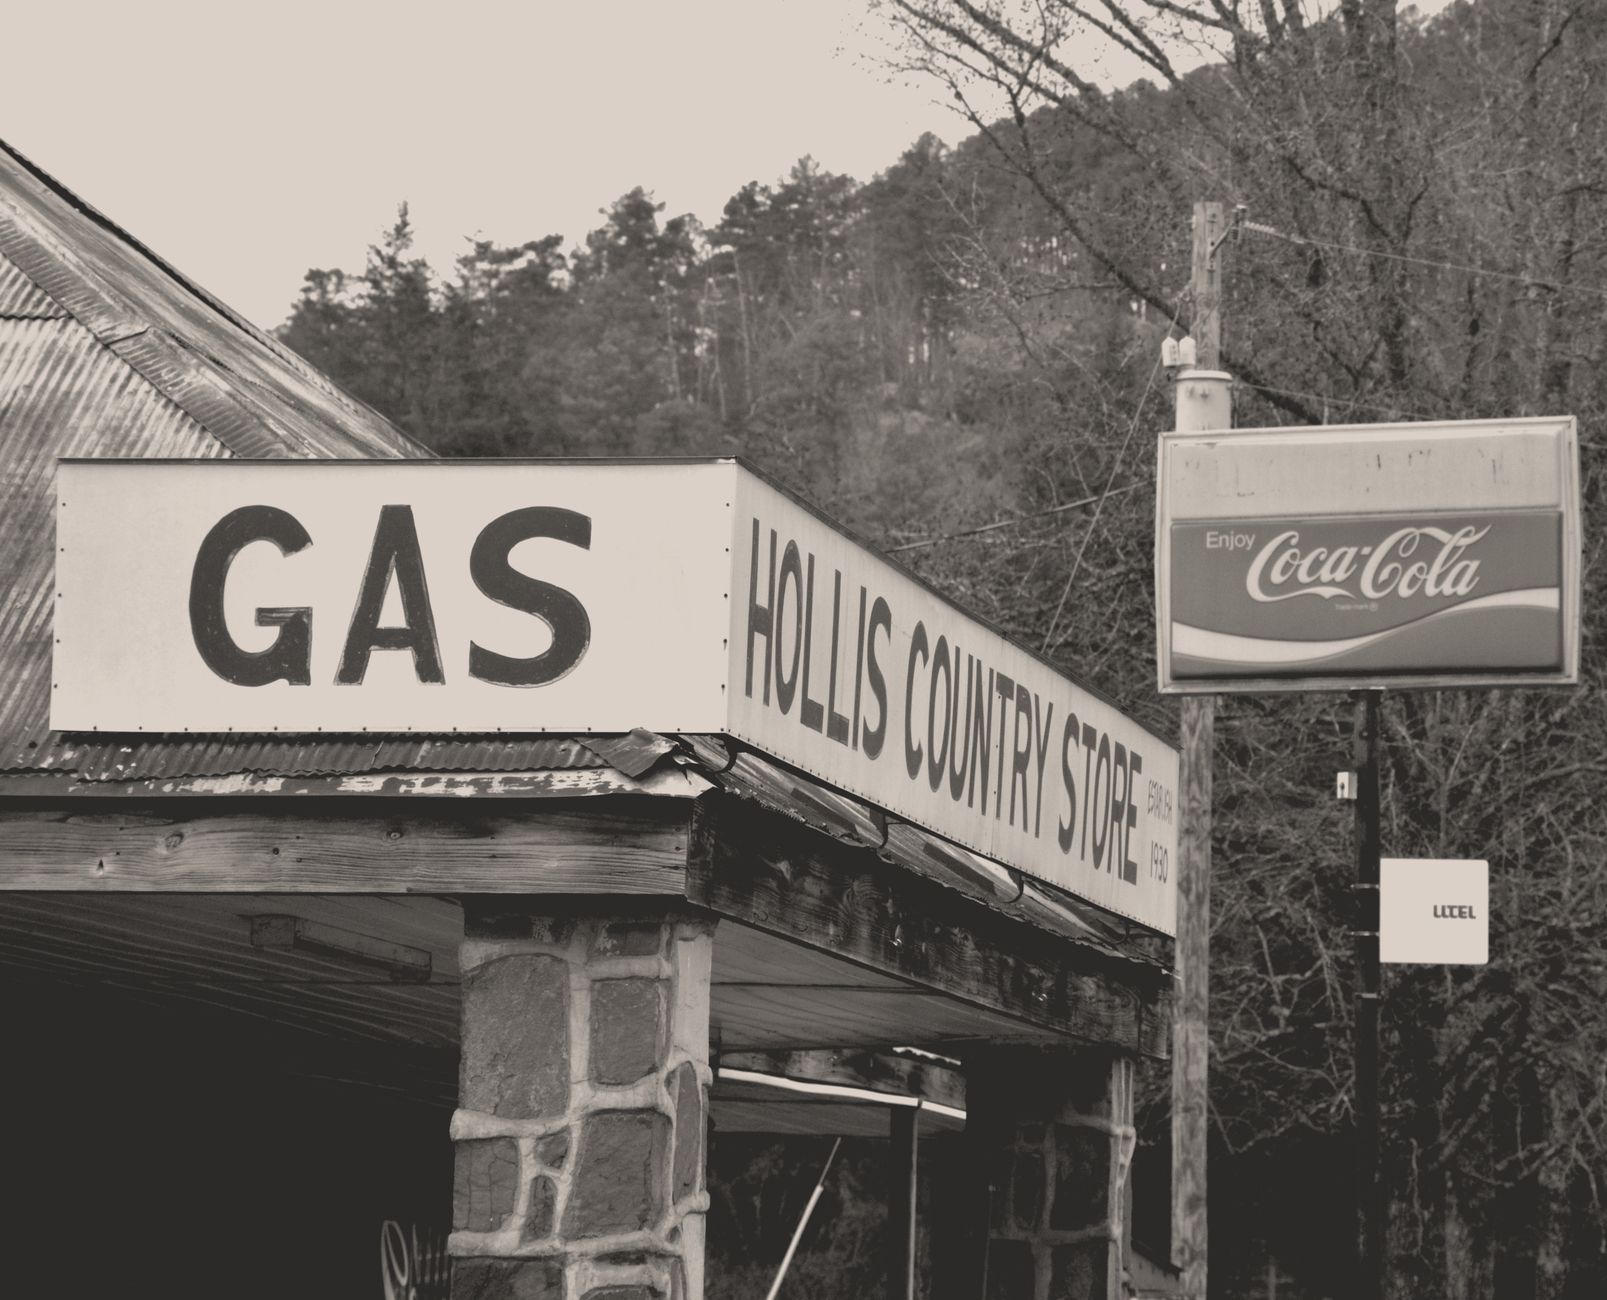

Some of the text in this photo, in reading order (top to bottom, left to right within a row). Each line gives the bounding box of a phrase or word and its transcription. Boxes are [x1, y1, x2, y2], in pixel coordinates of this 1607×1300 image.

[1206, 531, 1256, 550] Enjoy
[1246, 523, 1492, 602] Coca-Cola
[189, 504, 592, 689] GAS
[745, 517, 1143, 886] HOLLIS COUNTRY STORE
[1150, 839, 1169, 884] 1930
